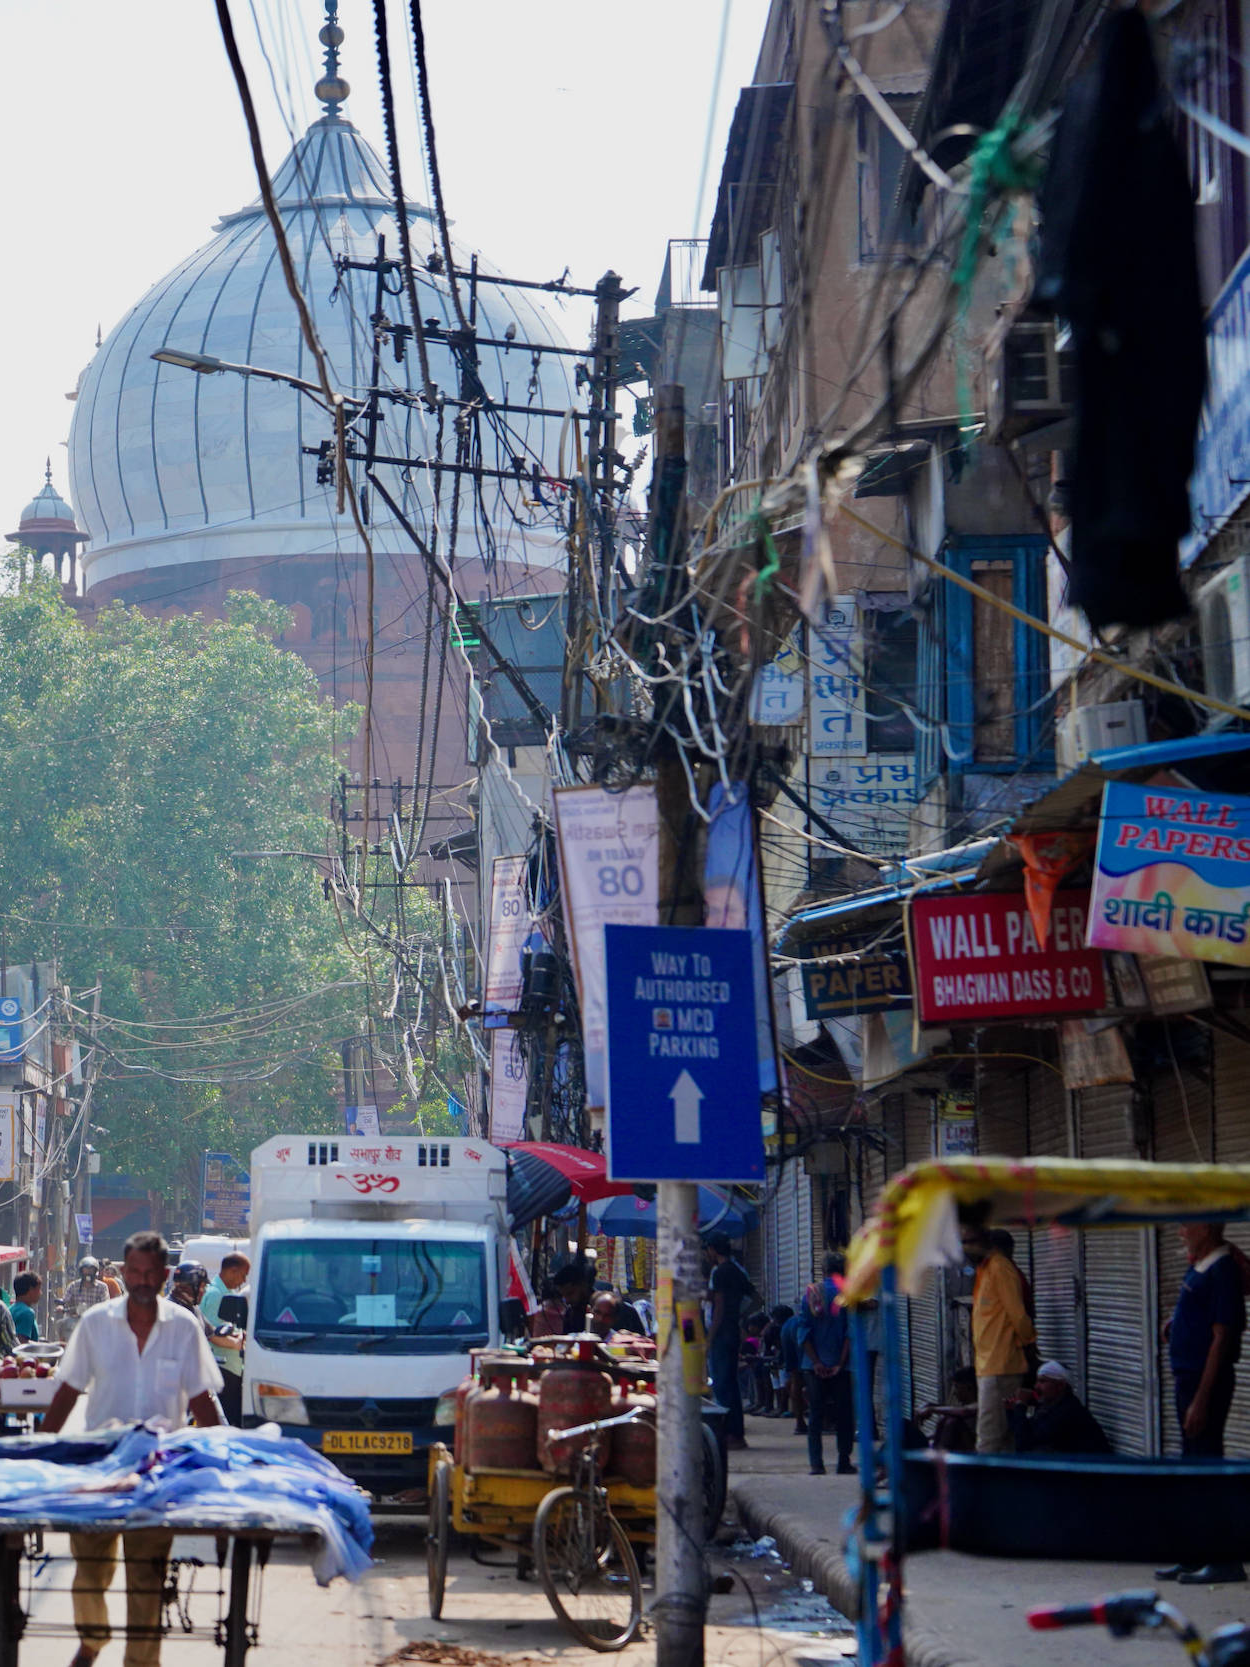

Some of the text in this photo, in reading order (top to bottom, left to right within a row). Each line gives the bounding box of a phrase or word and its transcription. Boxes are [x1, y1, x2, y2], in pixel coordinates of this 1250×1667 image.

[1144, 796, 1239, 829] WALL
[1116, 824, 1250, 862] PAPERS
[929, 907, 1088, 960] WALL PAER
[1103, 891, 1250, 944] शादी कार्ड
[651, 952, 687, 976] WAY
[635, 977, 730, 1003] AUTHORISED
[811, 964, 902, 998] PAPER
[933, 967, 1092, 1007] BHAGWAN DASS & CO
[678, 1008, 714, 1032] MCD
[649, 1032, 719, 1058] PARKING
